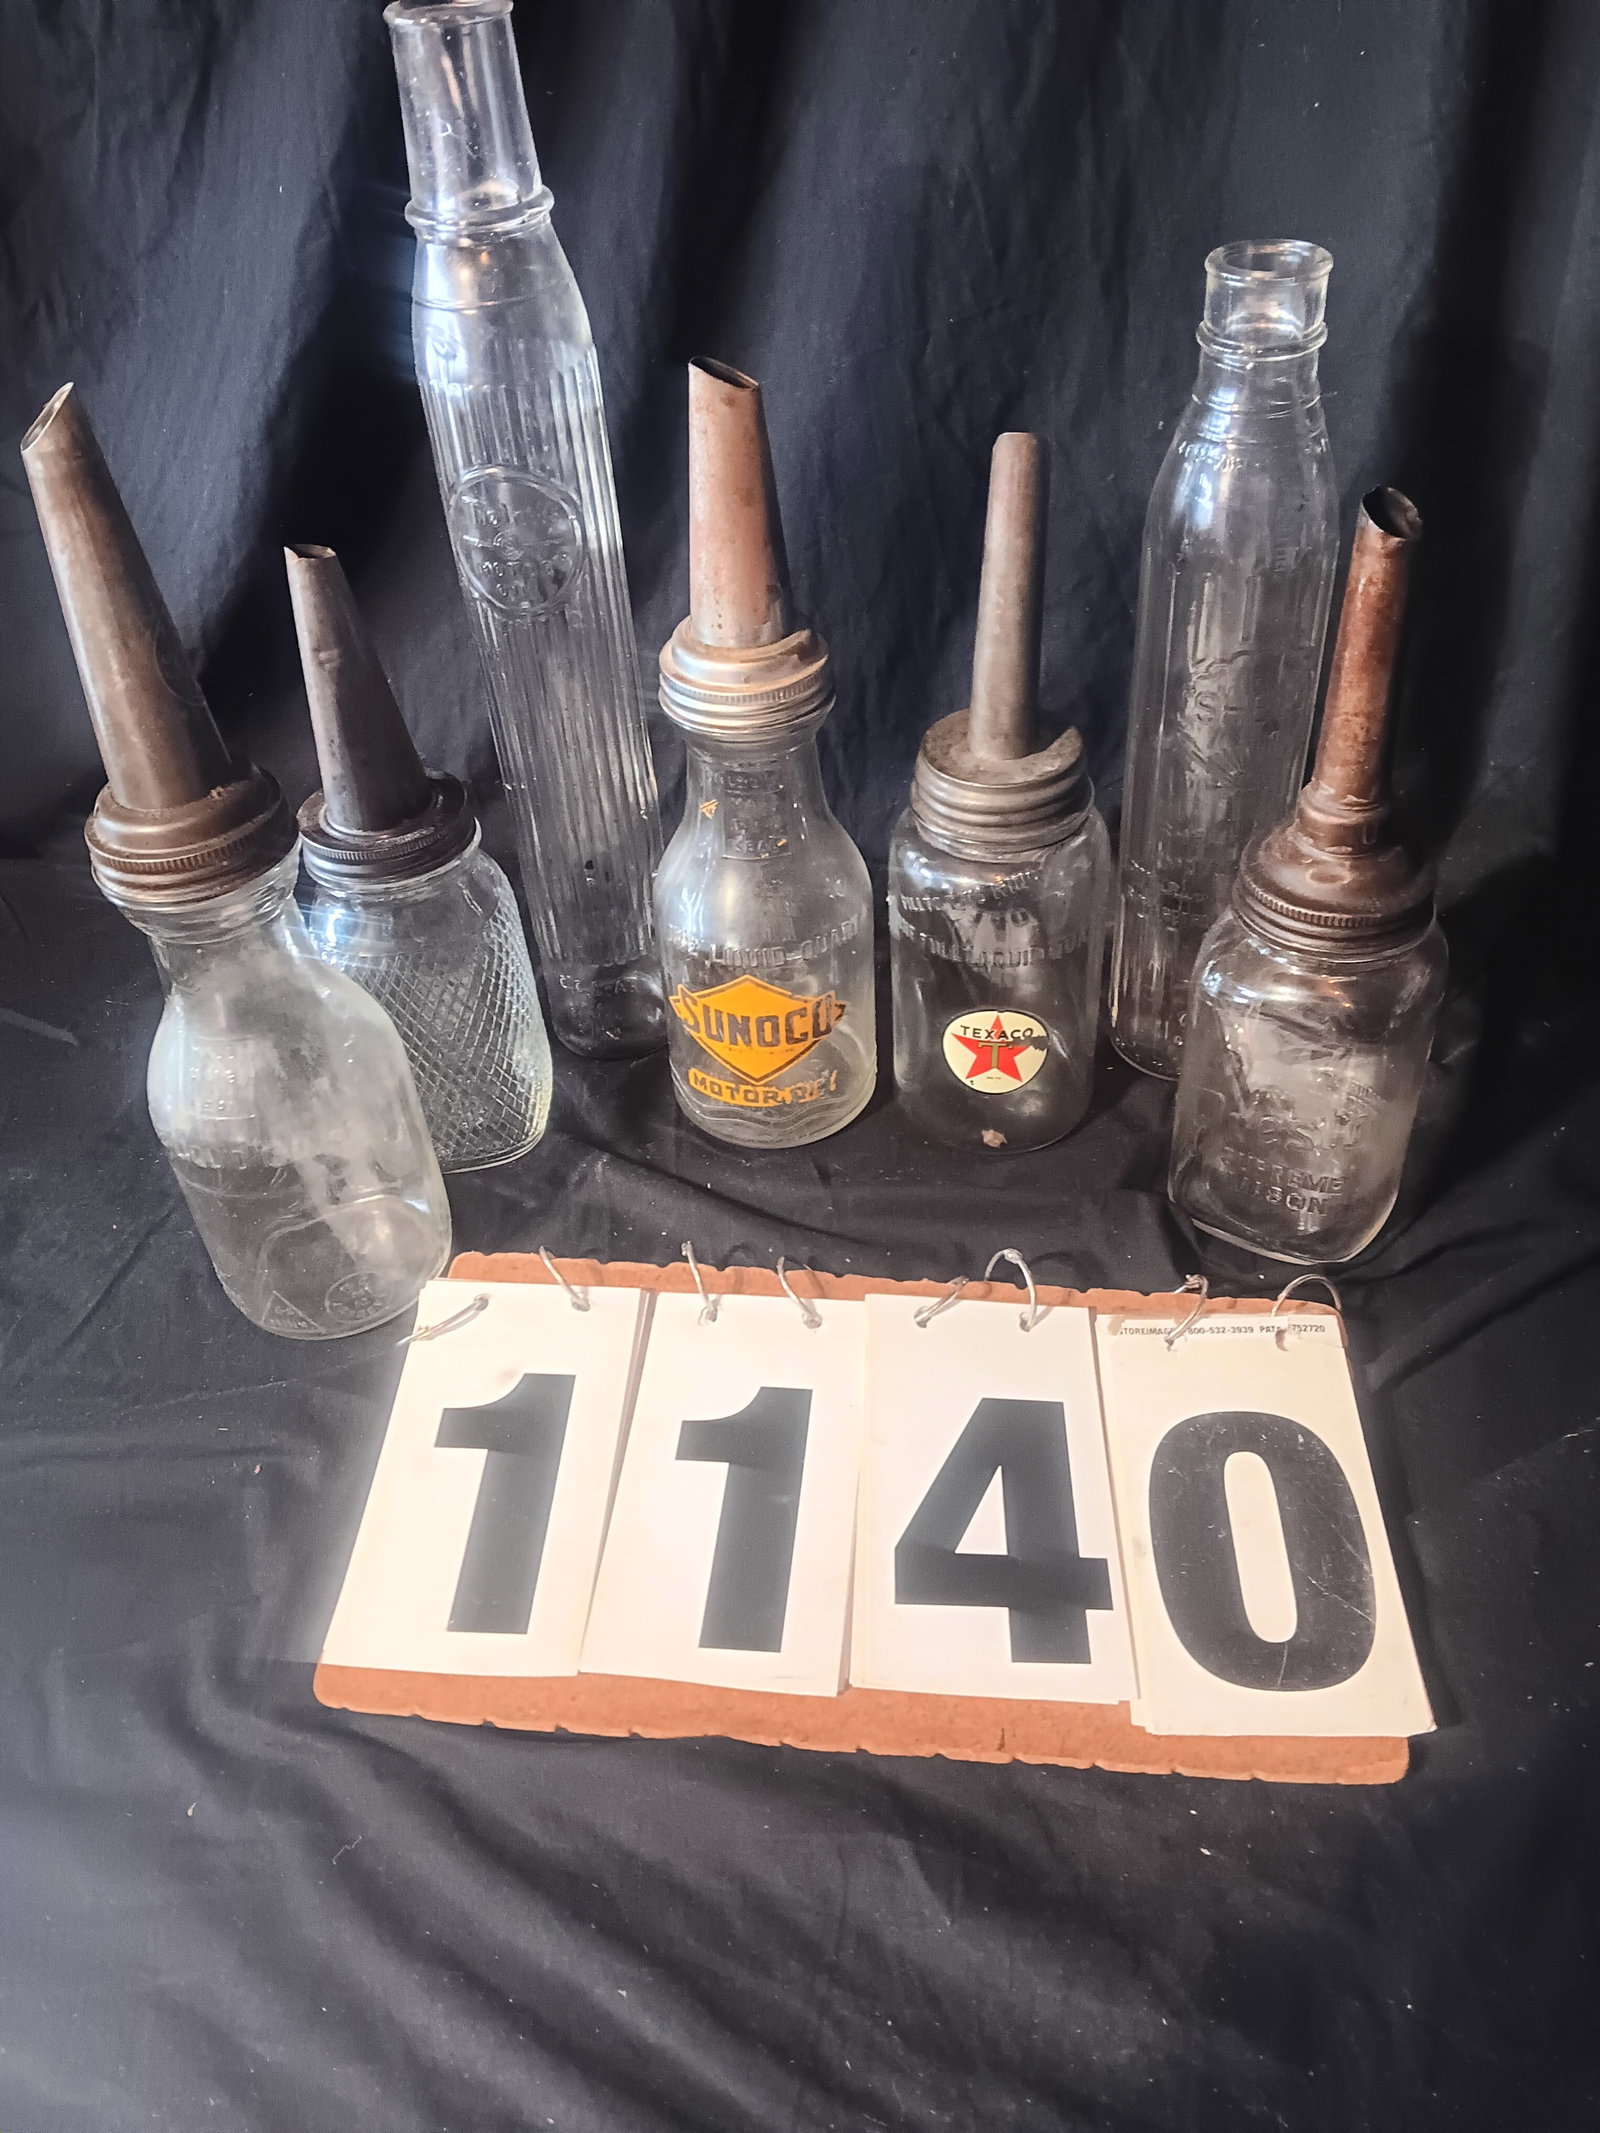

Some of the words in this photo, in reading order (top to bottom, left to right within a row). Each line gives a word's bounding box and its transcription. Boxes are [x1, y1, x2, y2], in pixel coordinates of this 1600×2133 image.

[678, 988, 834, 1049] SUNOCO
[960, 1024, 1034, 1041] TEXACO
[693, 1072, 783, 1105] MOTOR
[433, 1373, 1378, 1693] 1140
